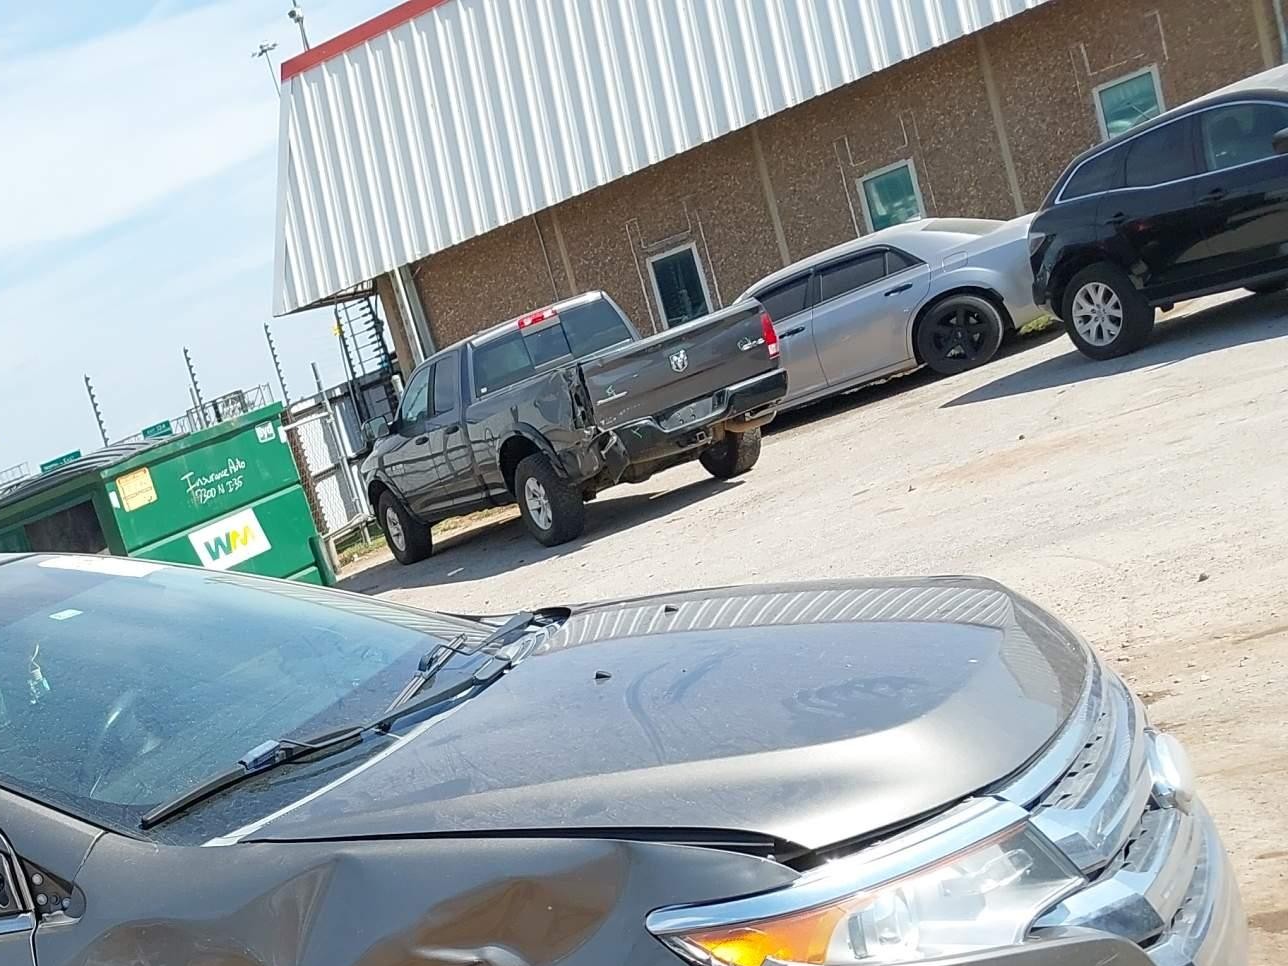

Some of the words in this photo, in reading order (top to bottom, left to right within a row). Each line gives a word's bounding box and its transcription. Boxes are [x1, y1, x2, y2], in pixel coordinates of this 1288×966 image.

[180, 468, 230, 493] Insurance
[227, 457, 246, 474] Auto
[203, 525, 255, 561] WM
